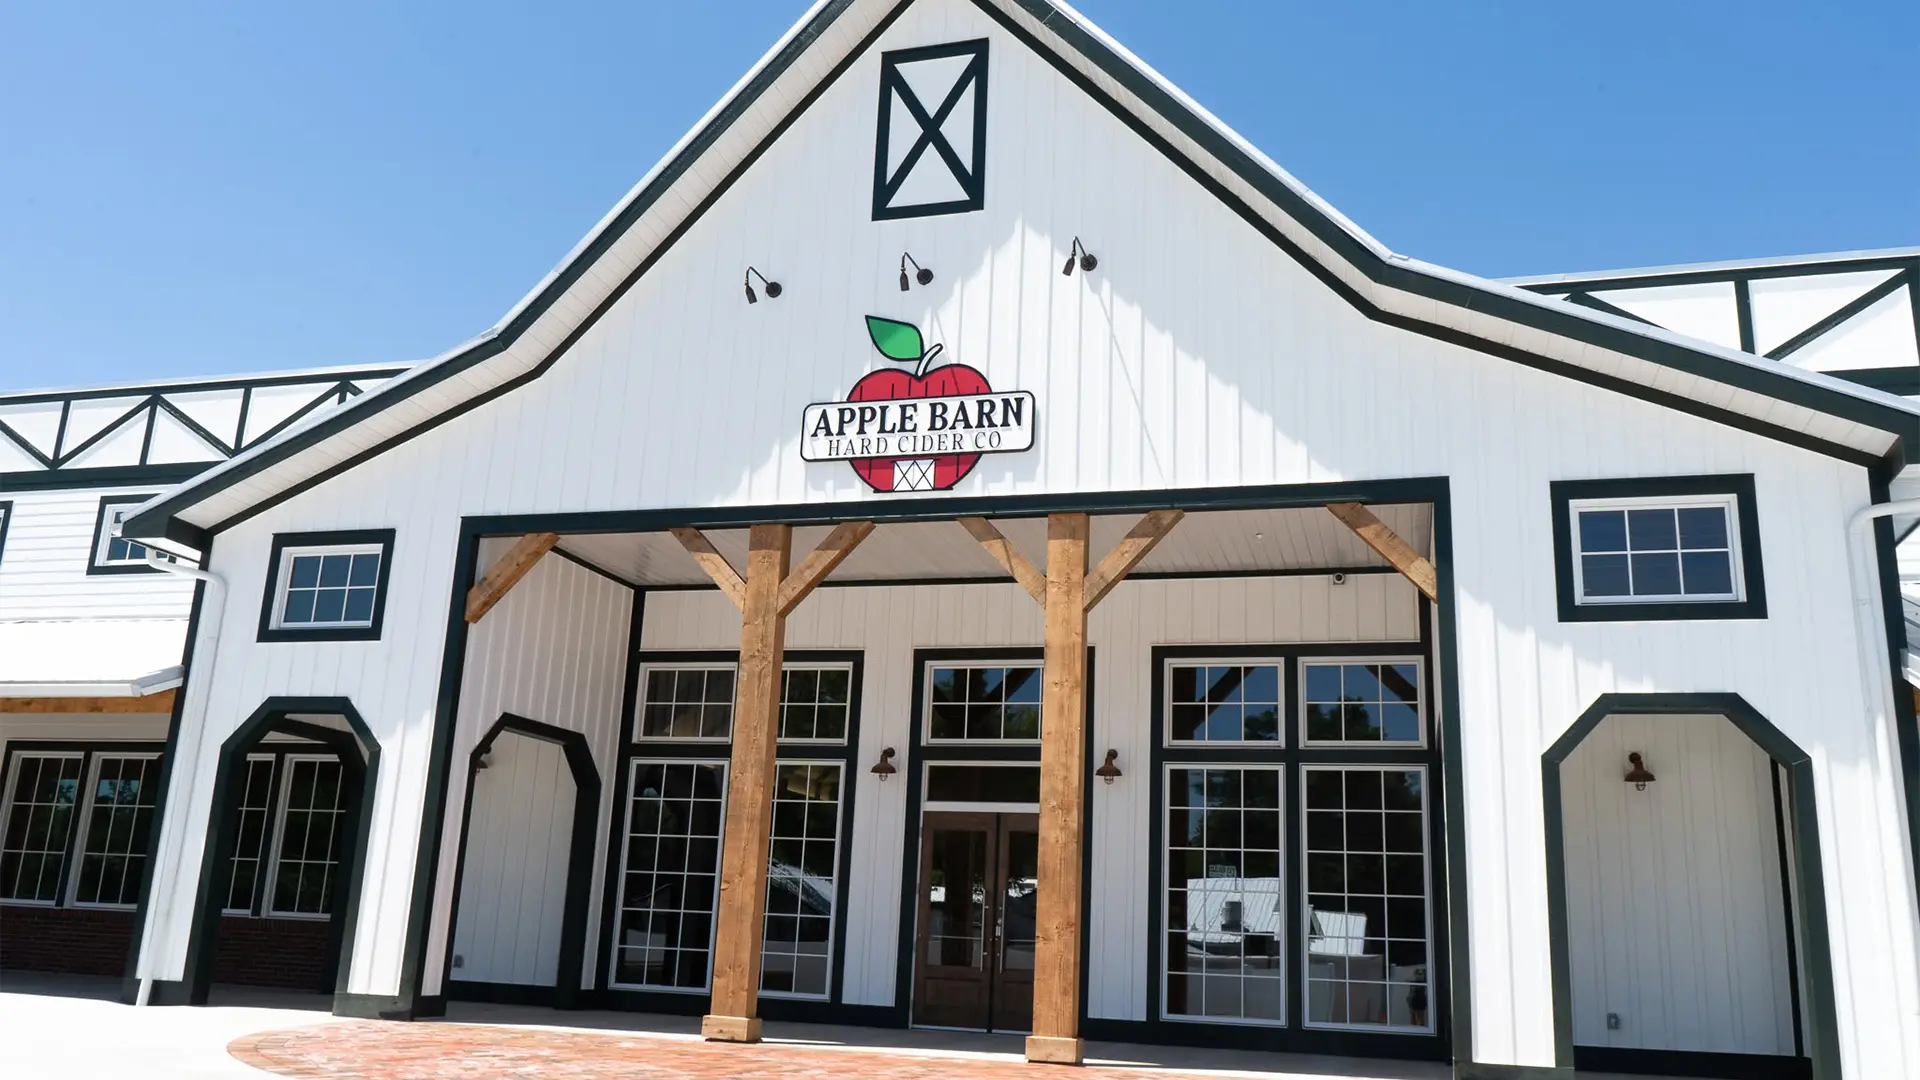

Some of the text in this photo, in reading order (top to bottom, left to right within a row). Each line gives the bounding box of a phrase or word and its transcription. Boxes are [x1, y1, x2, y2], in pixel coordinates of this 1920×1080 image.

[811, 397, 1025, 437] APPLE BARN
[828, 431, 1002, 456] HARD CIDER CO
